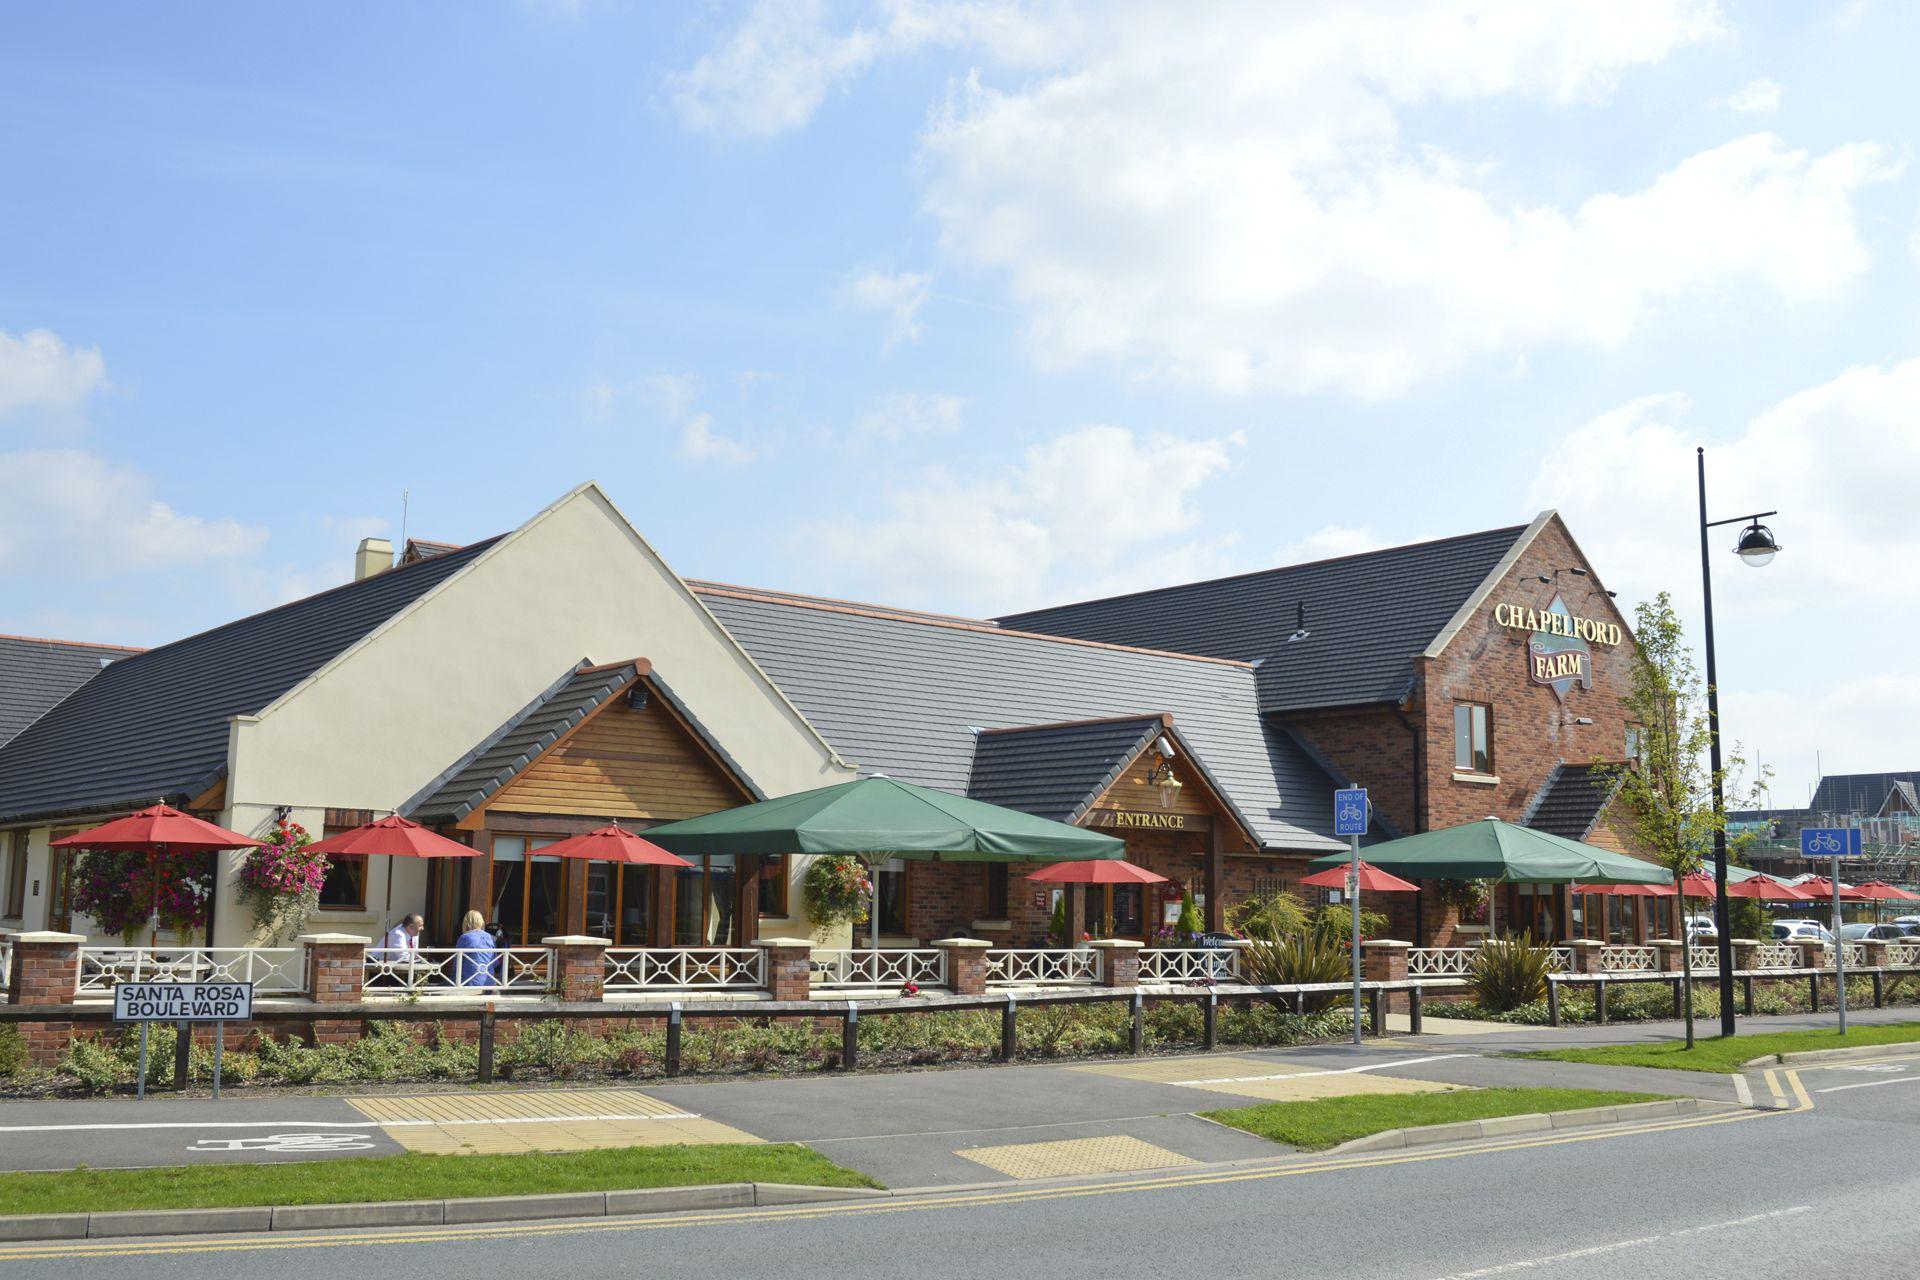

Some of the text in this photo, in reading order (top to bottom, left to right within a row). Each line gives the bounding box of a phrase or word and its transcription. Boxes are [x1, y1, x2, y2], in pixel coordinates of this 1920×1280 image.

[1495, 603, 1622, 646] CHAPELFORD
[1535, 653, 1582, 678] FARM
[1338, 792, 1364, 801] END OF
[1116, 812, 1184, 829] ENTRANCE
[1340, 823, 1363, 831] ROUTE
[122, 987, 245, 1001] SANTA ROSA
[127, 1002, 239, 1017] BOULEVARD
